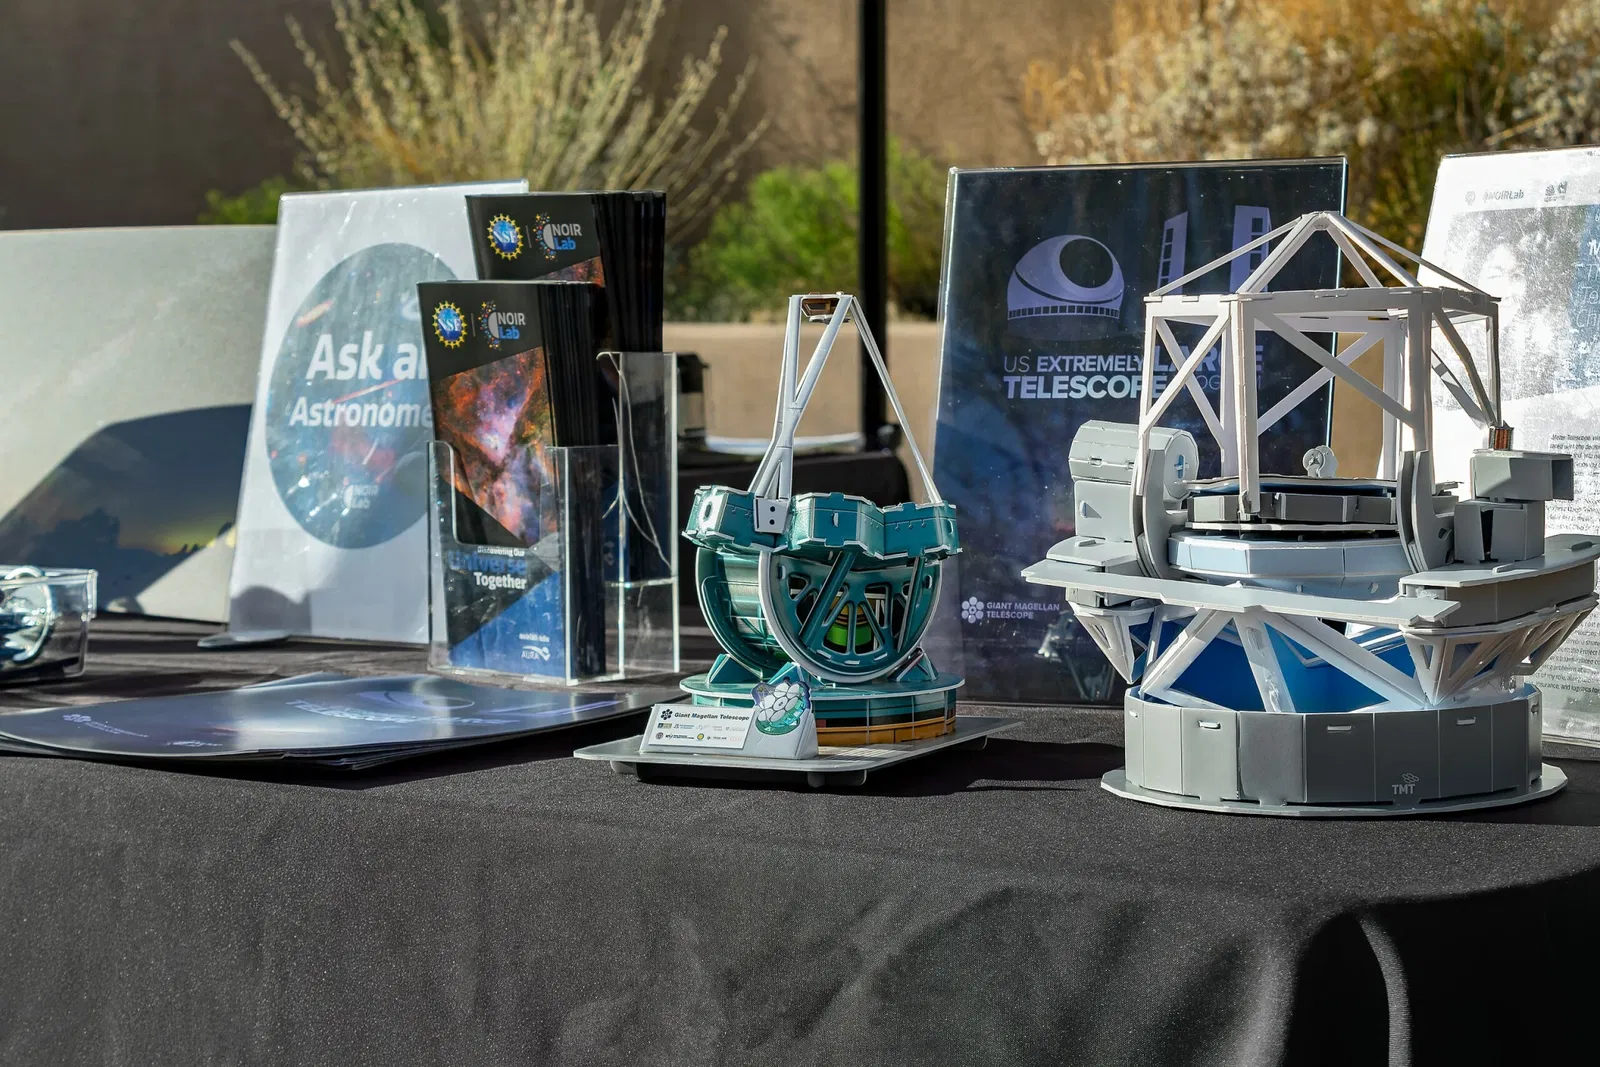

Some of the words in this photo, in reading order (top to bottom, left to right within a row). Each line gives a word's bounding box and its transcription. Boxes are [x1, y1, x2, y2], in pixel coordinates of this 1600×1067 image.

[493, 229, 518, 244] NSF
[552, 223, 582, 237] NOIR
[554, 237, 577, 250] Lab
[438, 317, 462, 332] NSF
[497, 312, 526, 326] NOIR
[500, 326, 520, 340] Lab
[305, 330, 384, 380] Ask
[1003, 356, 1030, 373] US
[1036, 355, 1145, 373] EXTREMELY
[448, 551, 528, 574] Universe
[473, 571, 527, 590] Together
[986, 602, 1013, 610] GIANT
[1014, 603, 1060, 611] MAGELLAN
[986, 611, 1034, 619] TELESCOPE
[691, 712, 719, 721] Magellan
[719, 713, 750, 723] Telescope
[1391, 783, 1416, 795] TMT
